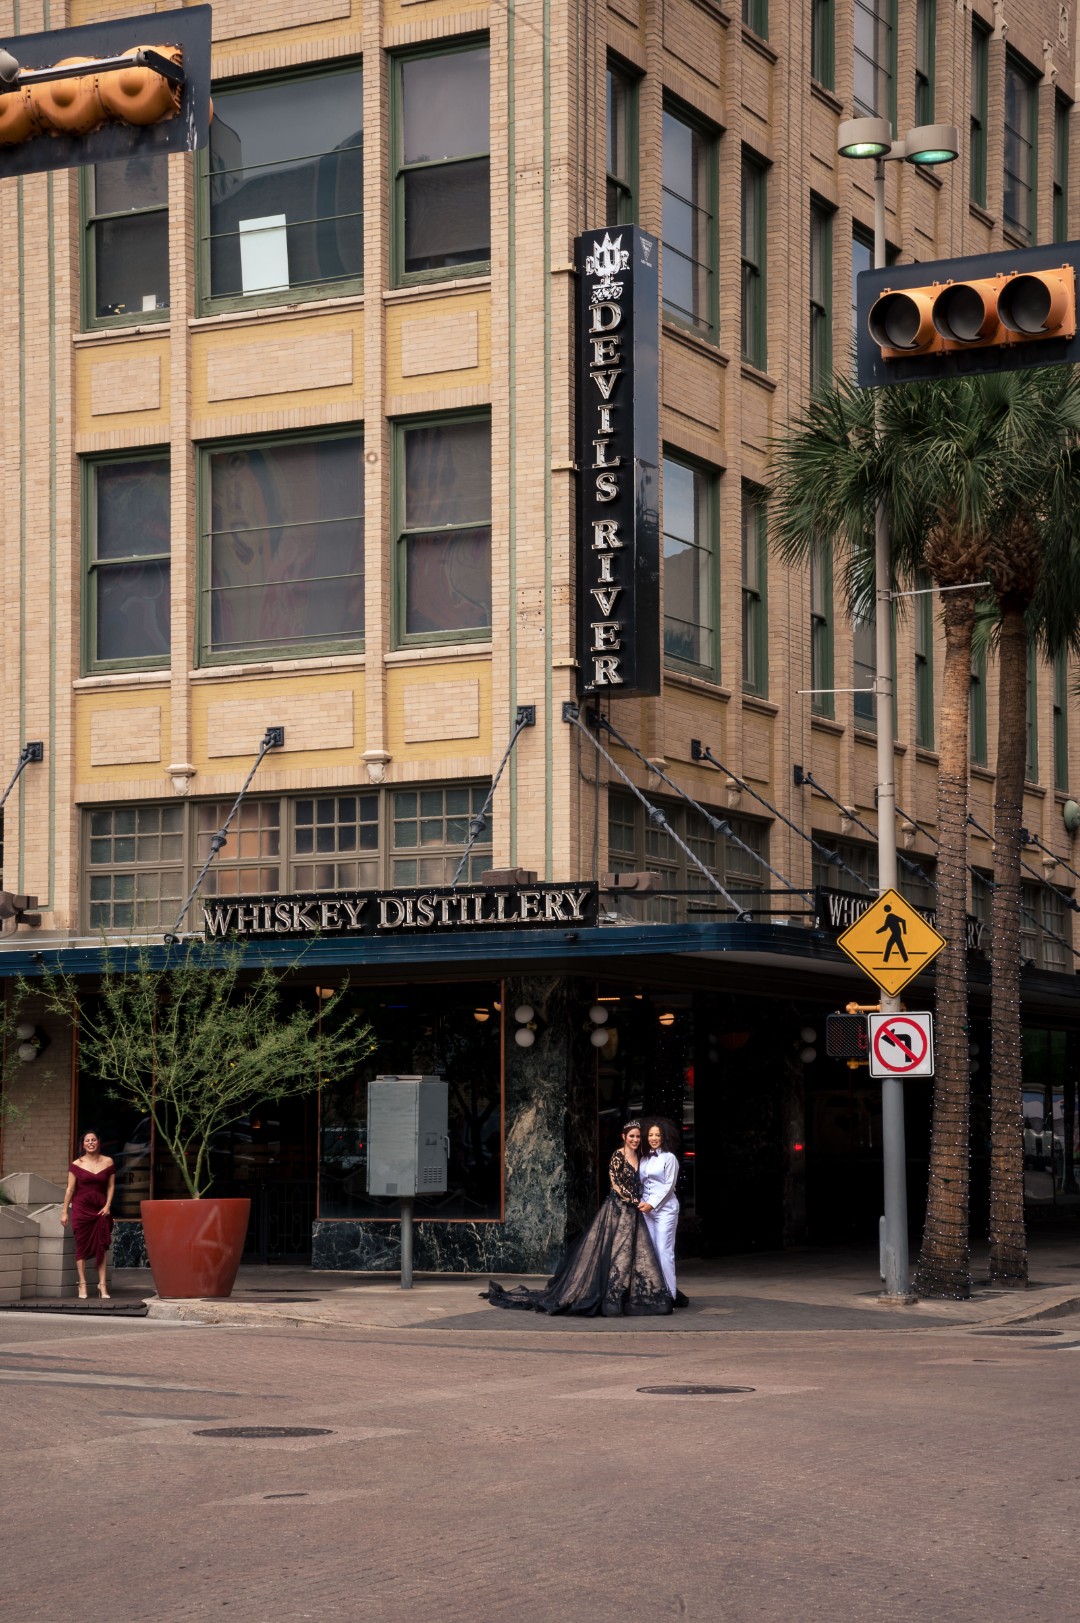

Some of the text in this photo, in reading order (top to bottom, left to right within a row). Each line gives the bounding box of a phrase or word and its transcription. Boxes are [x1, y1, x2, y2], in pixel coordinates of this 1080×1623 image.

[588, 302, 623, 502] DEVILS
[590, 520, 623, 685] RIVER
[202, 889, 590, 936] WHISKEY DISTILLERY
